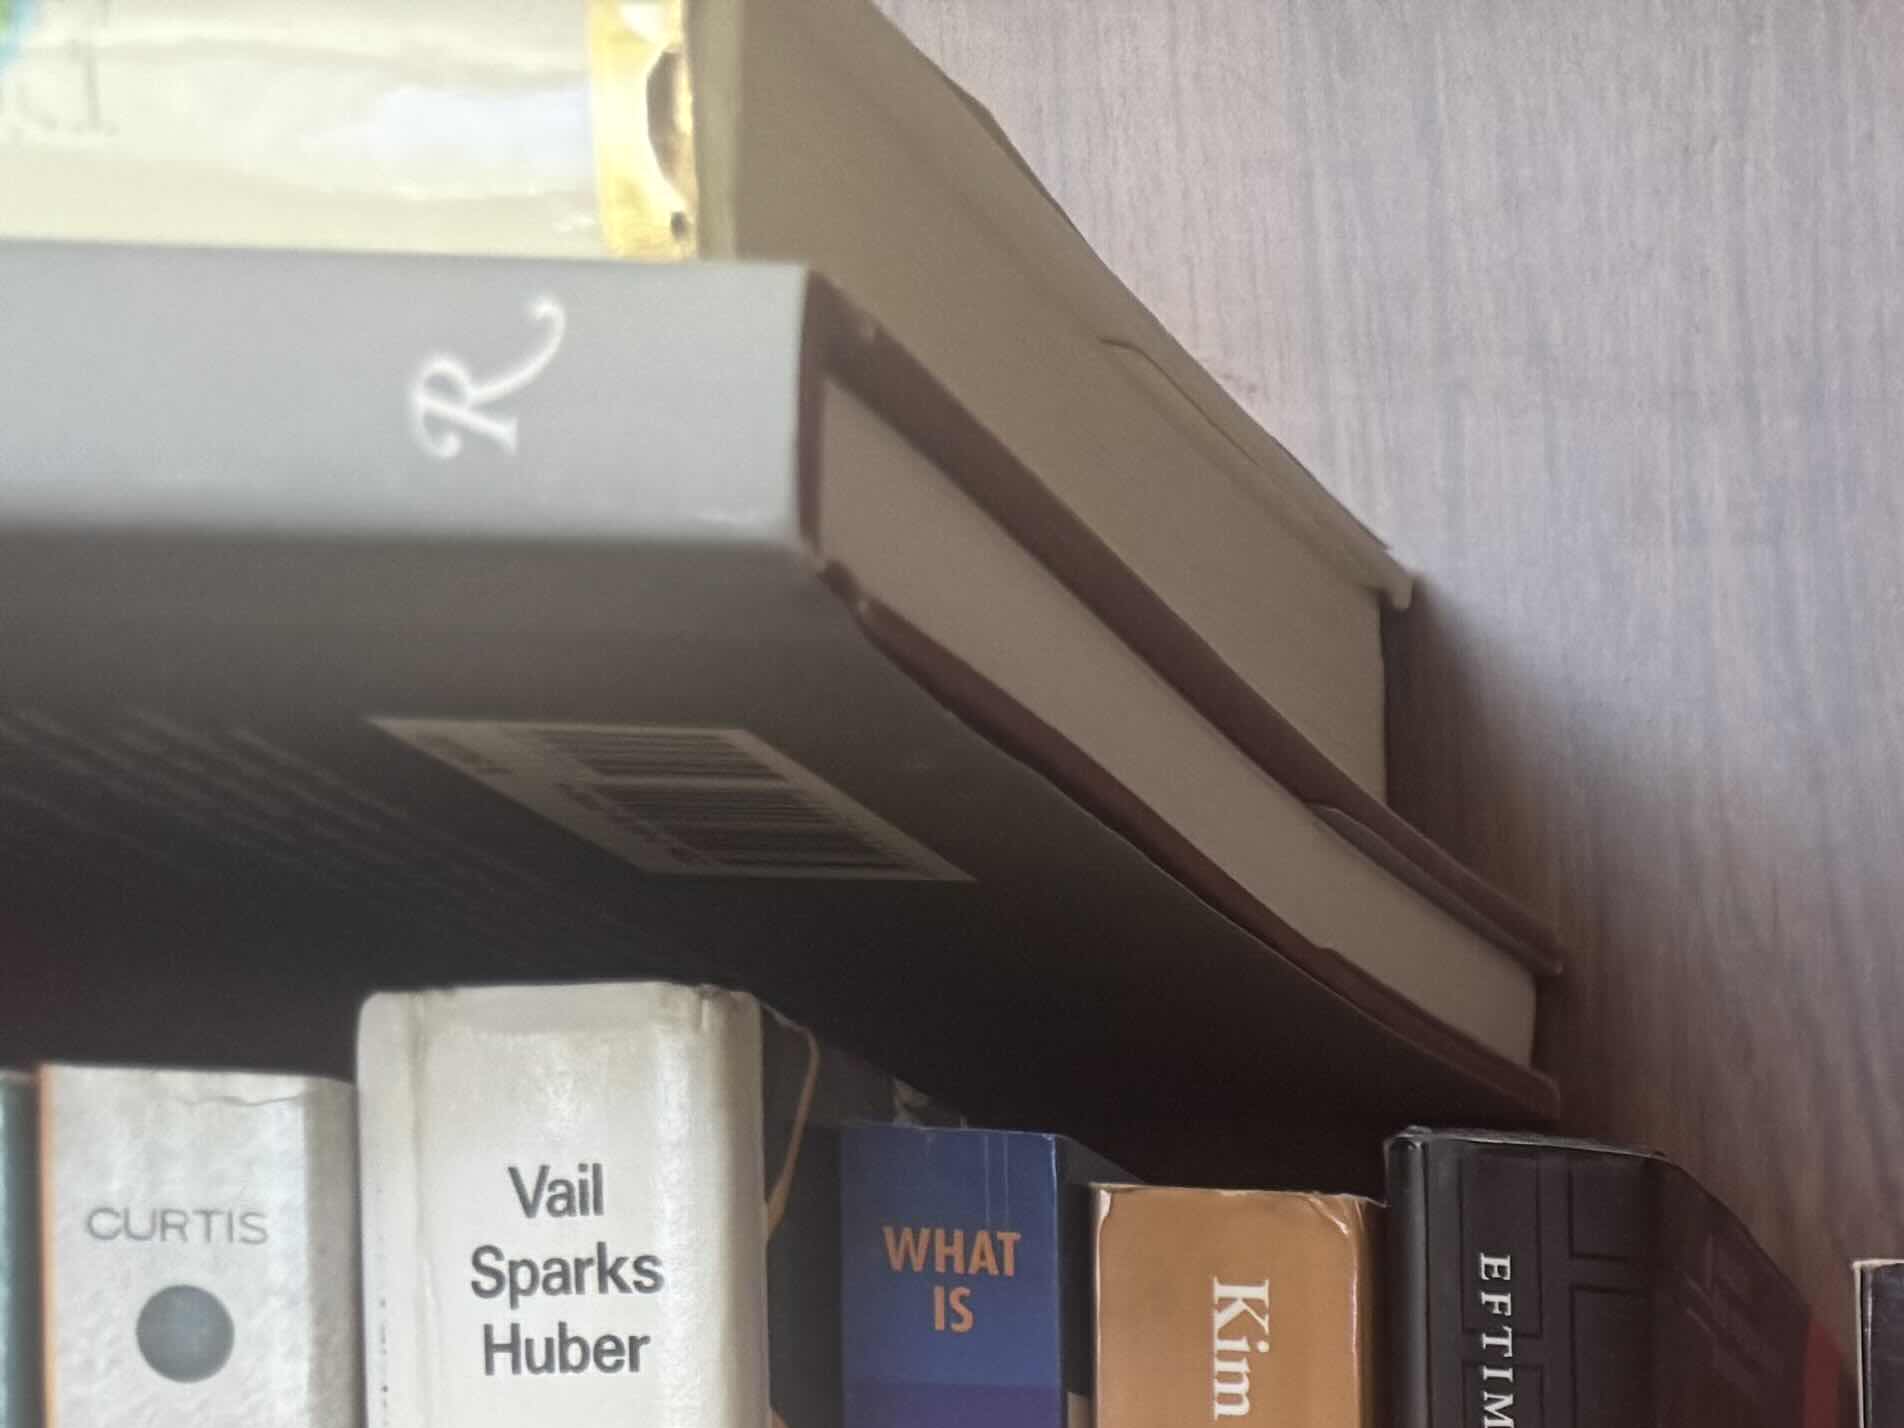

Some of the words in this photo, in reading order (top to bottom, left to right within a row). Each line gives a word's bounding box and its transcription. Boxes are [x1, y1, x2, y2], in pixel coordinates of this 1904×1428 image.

[507, 1162, 606, 1219] Vail
[85, 1206, 270, 1247] CURTIS
[883, 1225, 1022, 1277] WHAT
[470, 1243, 665, 1300] Sparks
[932, 1285, 975, 1334] IS
[482, 1322, 652, 1377] Huber
[1210, 1275, 1273, 1421] Kim
